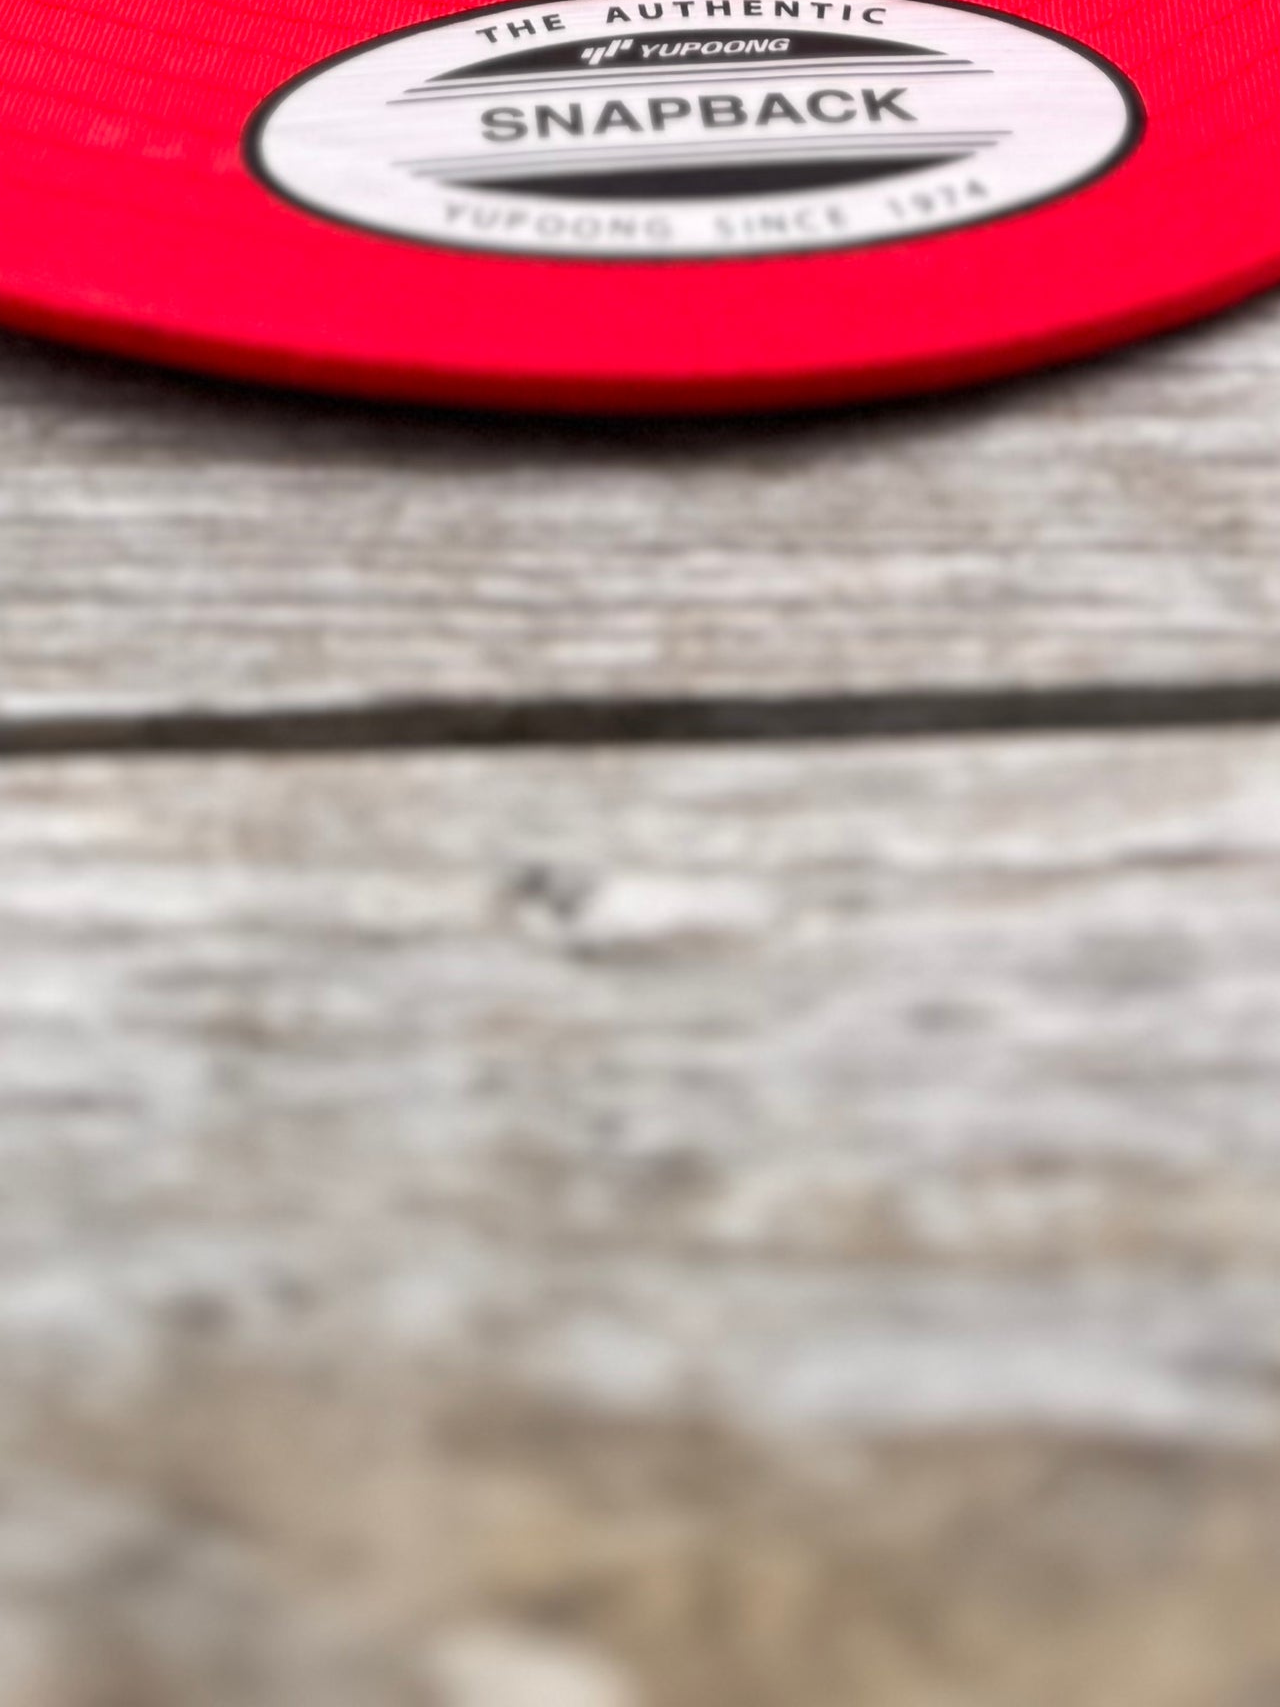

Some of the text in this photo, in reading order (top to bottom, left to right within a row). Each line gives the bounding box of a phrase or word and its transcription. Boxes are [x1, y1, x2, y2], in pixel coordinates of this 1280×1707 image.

[476, 0, 887, 44] THE AUTHENTIC
[640, 37, 791, 60] YUPOONG
[480, 88, 917, 143] SNAPBACK
